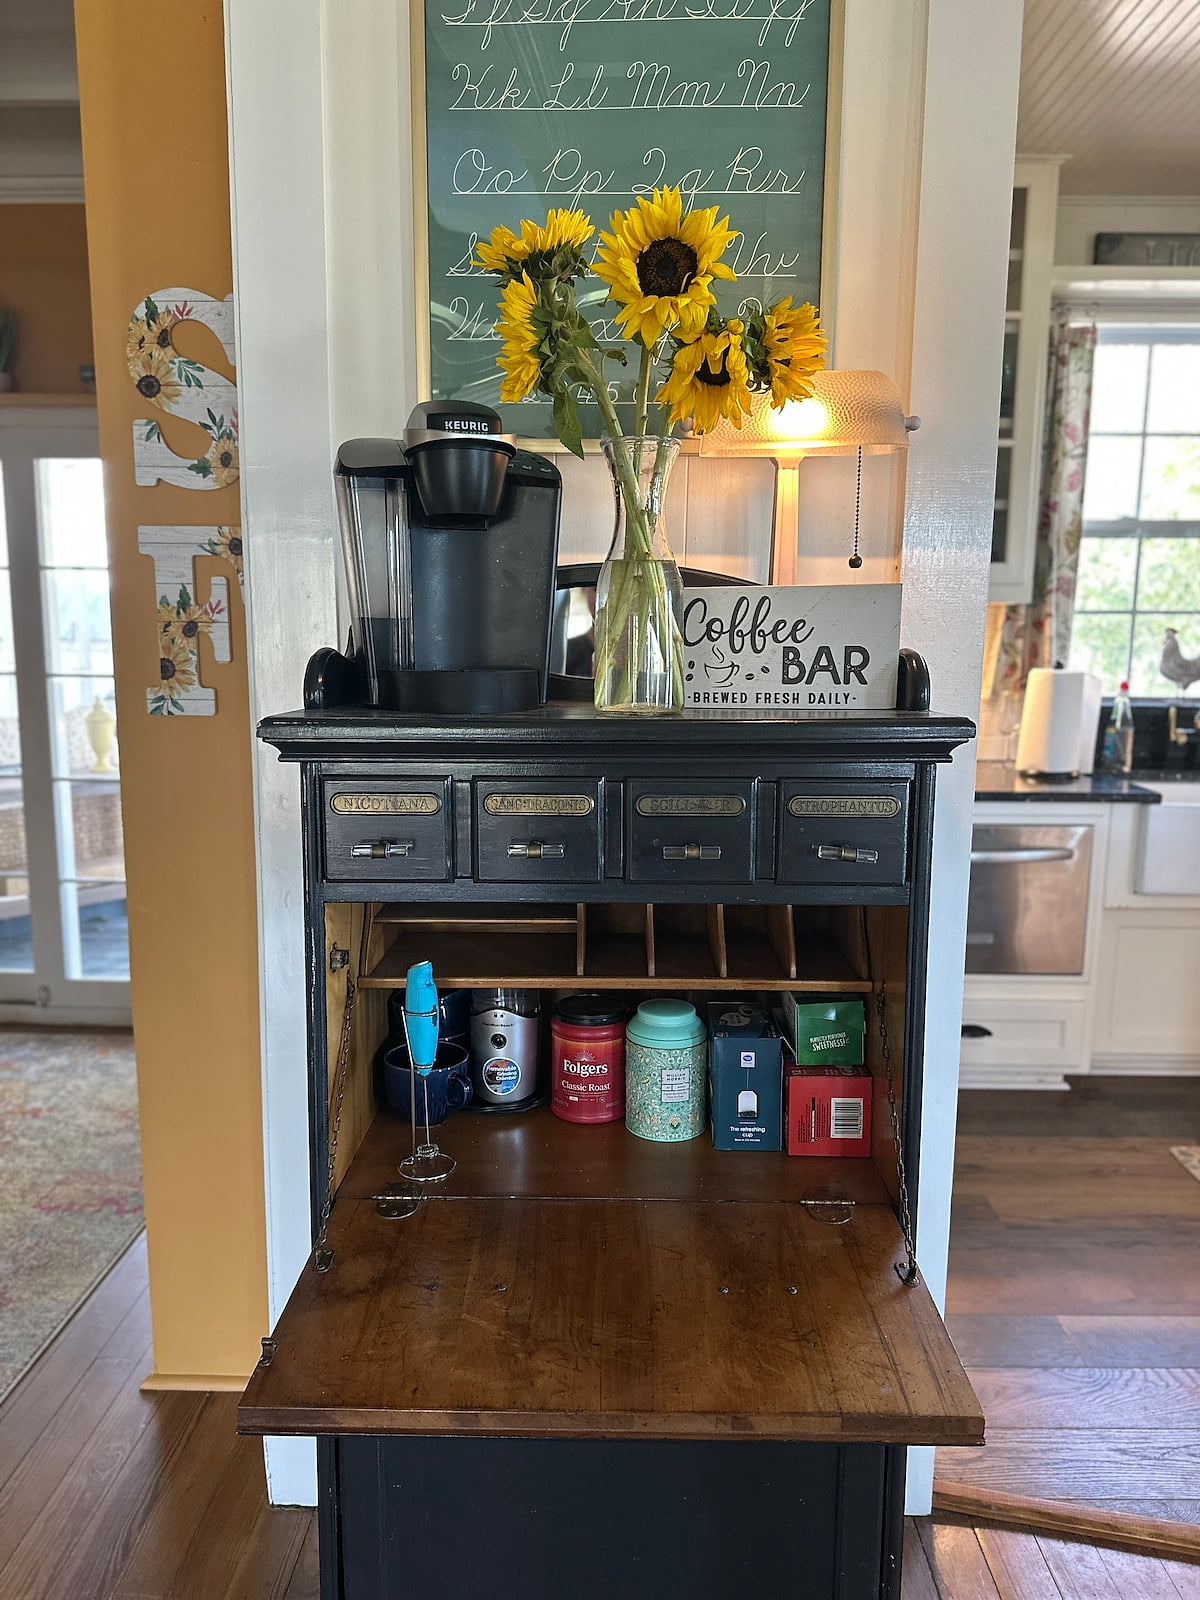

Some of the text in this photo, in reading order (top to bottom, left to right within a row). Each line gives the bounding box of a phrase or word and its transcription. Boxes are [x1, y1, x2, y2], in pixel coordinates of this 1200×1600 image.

[450, 58, 811, 112] Kk Ll Mm Nn
[452, 148, 529, 195] Oo
[542, 148, 616, 213] Pp
[725, 146, 806, 194] Rr
[726, 231, 800, 276] Vv
[444, 420, 489, 432] KEURIG
[683, 595, 815, 655] Coffee
[782, 645, 870, 686] BAR
[755, 692, 800, 705] FRESH
[343, 797, 431, 811] NICOTANA
[795, 800, 894, 814] STROPHANTUS
[812, 1038, 847, 1052] SWEETNESS!
[563, 1058, 609, 1078] Folgers
[561, 1079, 611, 1092] Classic Roast
